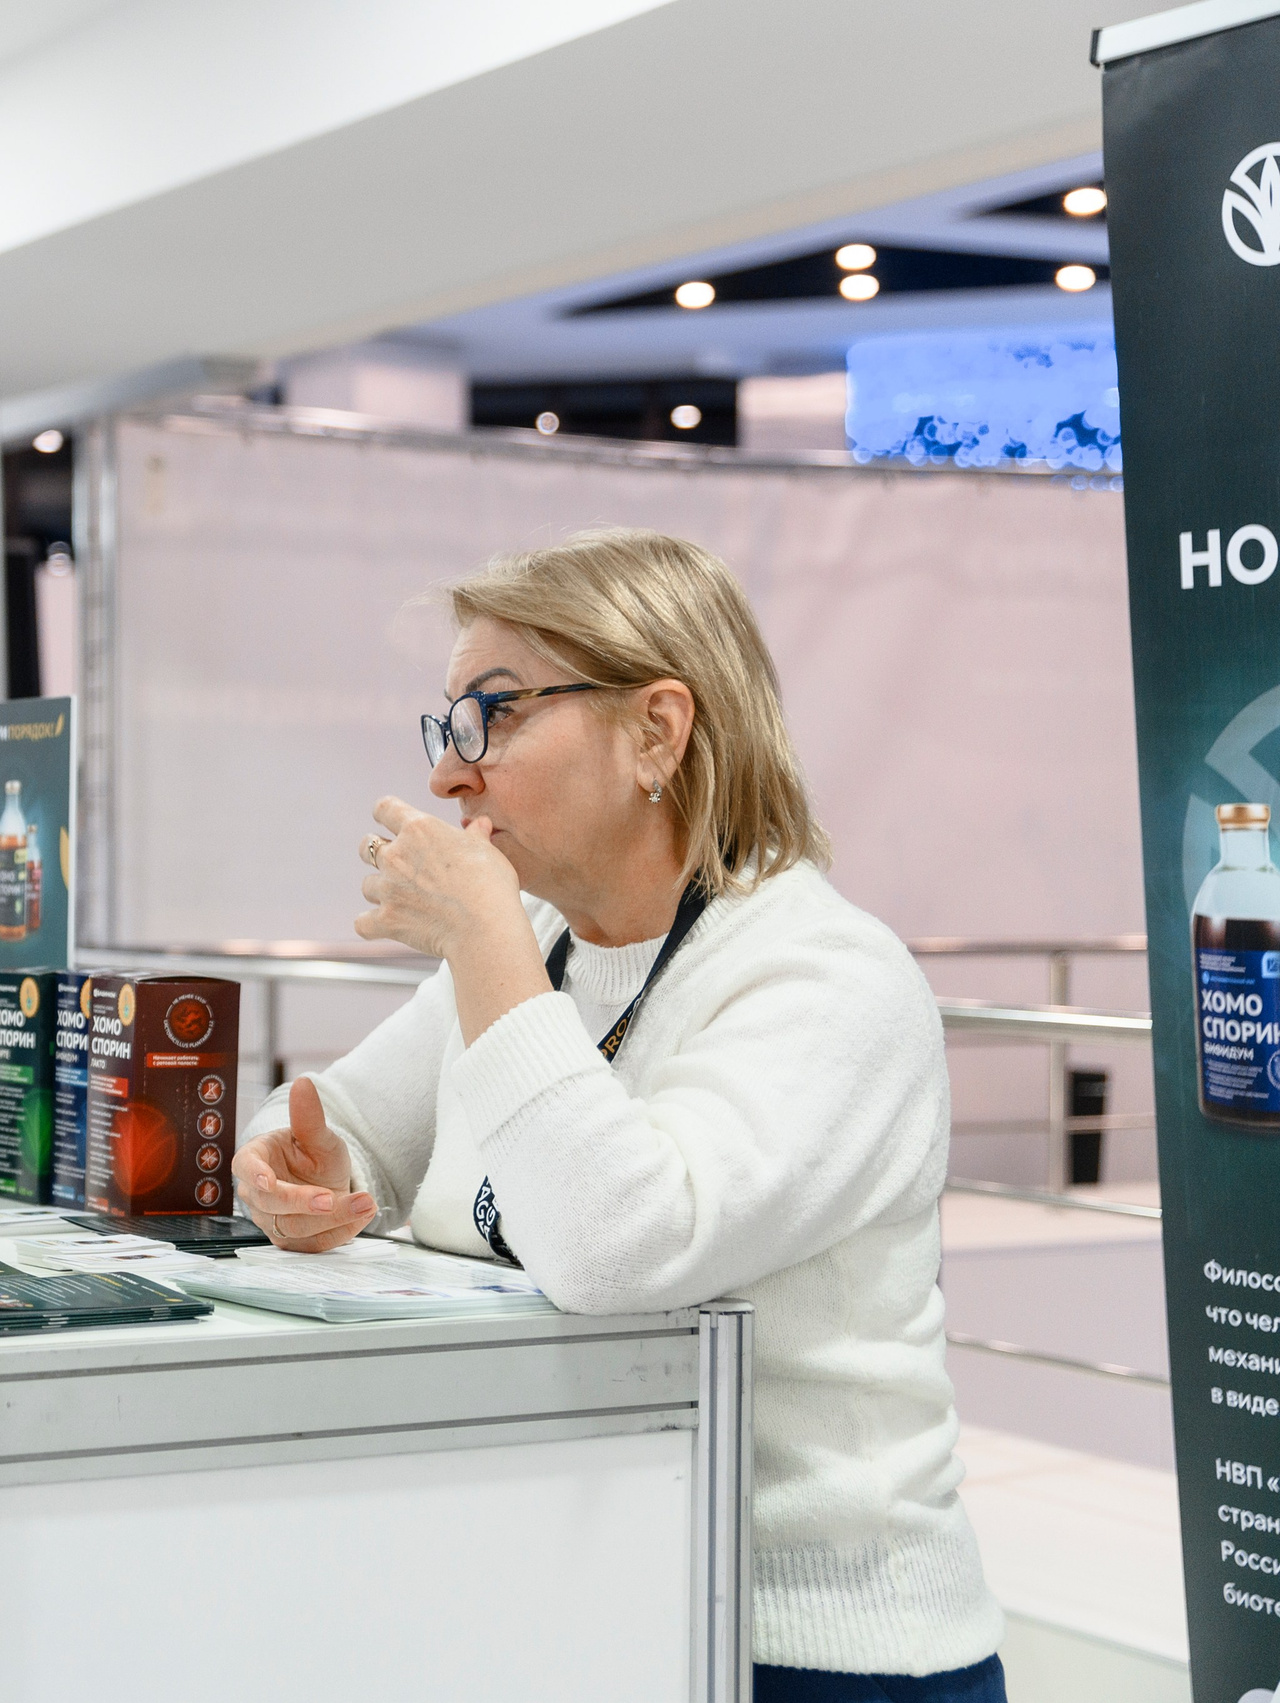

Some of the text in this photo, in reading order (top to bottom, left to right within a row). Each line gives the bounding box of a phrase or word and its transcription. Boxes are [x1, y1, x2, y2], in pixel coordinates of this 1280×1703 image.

[1201, 988, 1263, 1017] ХОМО
[56, 1009, 86, 1029] ХОМО
[91, 1015, 123, 1036] ХОМО
[56, 1030, 89, 1051] СПОРИ
[91, 1036, 132, 1060] СПОРИН
[1205, 1304, 1243, 1327] что
[1211, 1386, 1280, 1417] в виде
[1215, 1457, 1263, 1490] НВП
[1218, 1504, 1280, 1535] стран
